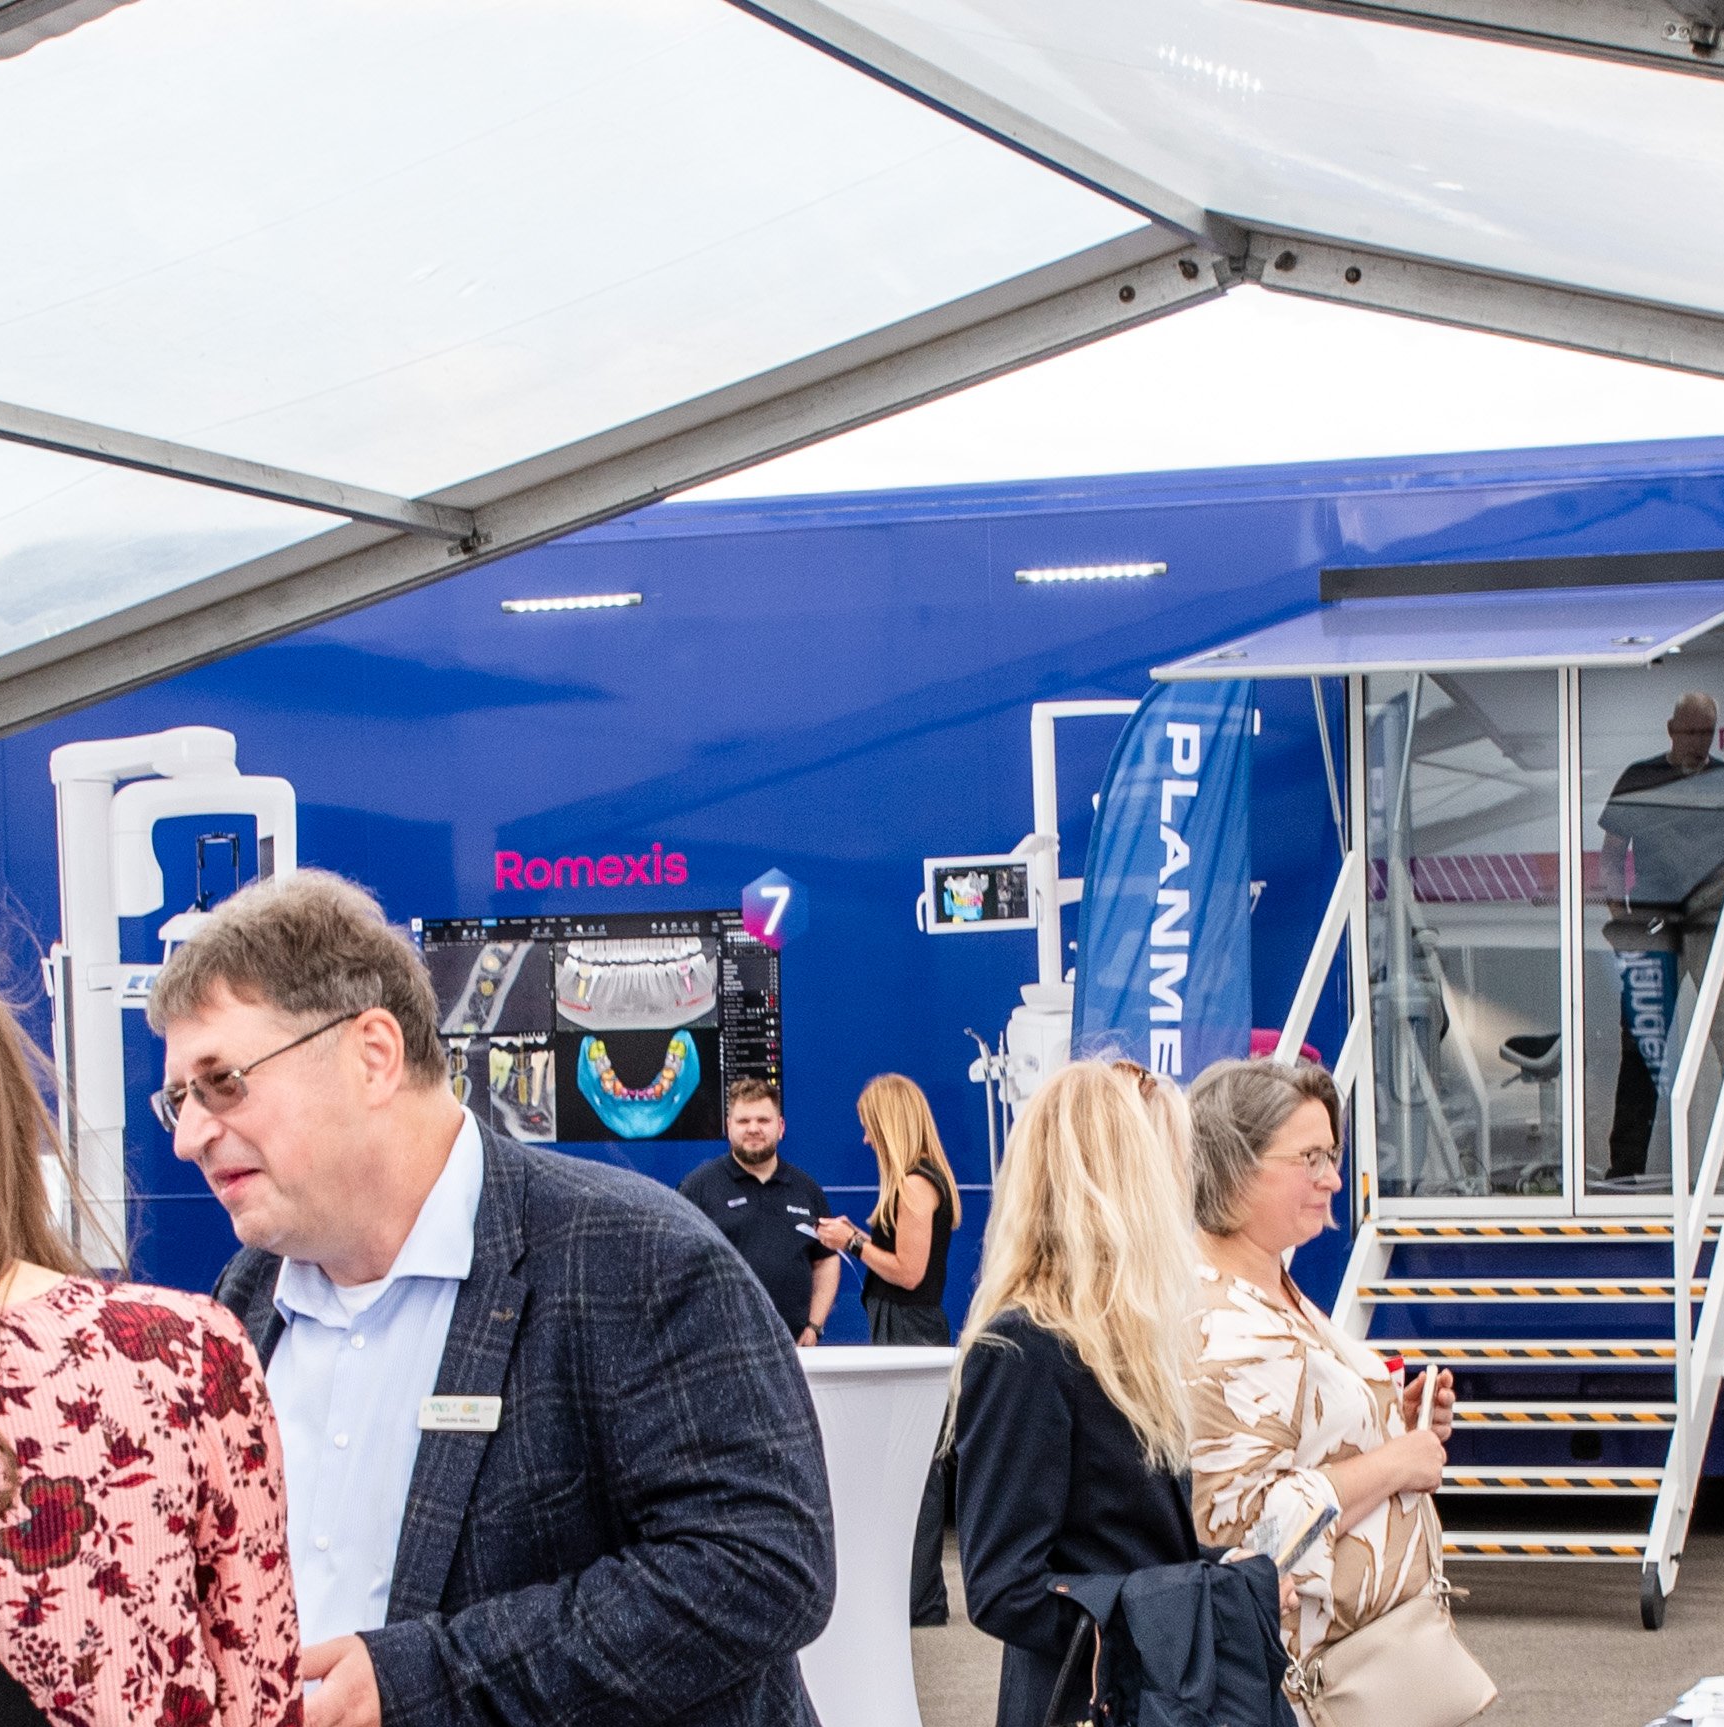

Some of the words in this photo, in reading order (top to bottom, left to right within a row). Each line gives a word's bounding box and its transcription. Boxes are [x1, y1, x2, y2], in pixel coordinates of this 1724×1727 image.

[494, 842, 689, 891] Romexis
[760, 886, 790, 936] 7
[1148, 721, 1201, 1077] PLANME
